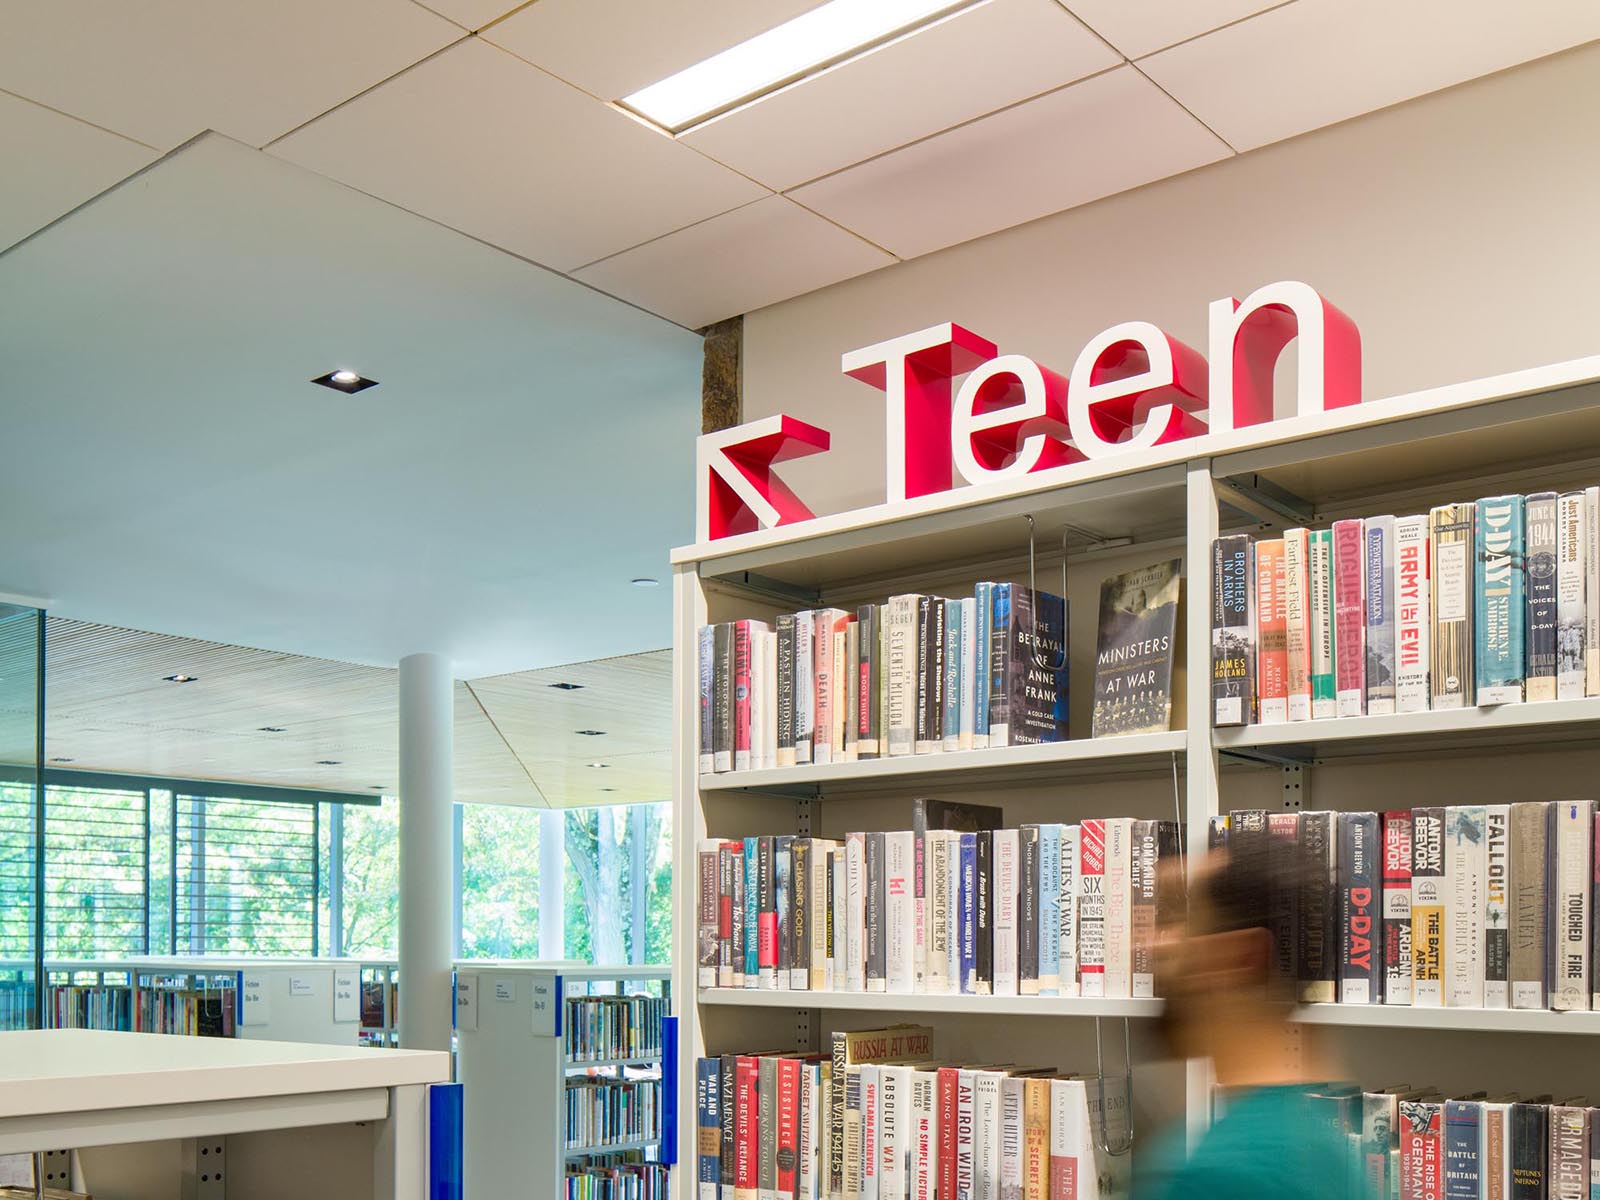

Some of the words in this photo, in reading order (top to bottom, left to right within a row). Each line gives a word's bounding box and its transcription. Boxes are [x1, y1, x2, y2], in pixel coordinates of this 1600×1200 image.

[843, 281, 1338, 505] Teen
[1485, 504, 1512, 587] D-DAY
[1224, 559, 1234, 572] IN
[1400, 546, 1419, 598] ARMY
[1223, 575, 1234, 607] ARMS
[1234, 552, 1245, 613] BROTHERS
[1401, 608, 1417, 620] OF
[1487, 596, 1498, 652] AMBROSE
[1499, 596, 1509, 645] STEPHEN
[1018, 631, 1064, 653] BETRAYAL
[1097, 636, 1168, 665] MINISTERS
[1401, 628, 1419, 667] EVIL
[1499, 647, 1508, 661] E.
[783, 650, 791, 674] PAST
[783, 681, 791, 692] IN
[1028, 669, 1055, 686] ANNE
[1105, 677, 1121, 694] AT
[1127, 669, 1156, 690] WAR
[1025, 686, 1057, 703] FRANK
[783, 698, 791, 741] HIDING
[1083, 835, 1104, 860] MICHAEL
[1354, 824, 1362, 848] ANTONY
[1415, 817, 1427, 871] BEEVOR
[1428, 816, 1440, 872] ANTONY
[1061, 838, 1072, 886] ALLIES
[1083, 852, 1101, 872] DOBBS
[1131, 846, 1140, 858] IN
[1354, 850, 1362, 874] BEEVOR
[1489, 814, 1504, 905] FALLOUT
[1131, 861, 1140, 889] CHIEF
[1144, 836, 1154, 898] COMMANDER
[1061, 888, 1072, 905] AT
[1083, 877, 1101, 894] SIX
[1061, 908, 1072, 937] WAR
[1350, 887, 1371, 970] D-DAY
[1569, 892, 1583, 942] TOUCHED
[1569, 954, 1583, 979] FIRE
[832, 1041, 846, 1080] RUSSIA
[723, 1072, 733, 1098] NAZI
[739, 1084, 748, 1101] THE
[832, 1083, 846, 1100] AT
[959, 1085, 972, 1103] AN
[739, 1103, 748, 1137] DEVILS'
[781, 1066, 792, 1145] RESISTANCE
[832, 1102, 846, 1129] WAR
[723, 1101, 733, 1143] MENACE
[918, 1118, 928, 1132] NO
[959, 1110, 972, 1144] IRON
[739, 1140, 748, 1182] ALLIANCE
[832, 1131, 846, 1172] 1941-45
[918, 1134, 928, 1167] SIMPLE
[1425, 1138, 1435, 1161] THE
[959, 1152, 972, 1190] WIND
[1425, 1164, 1435, 1189] RISE
